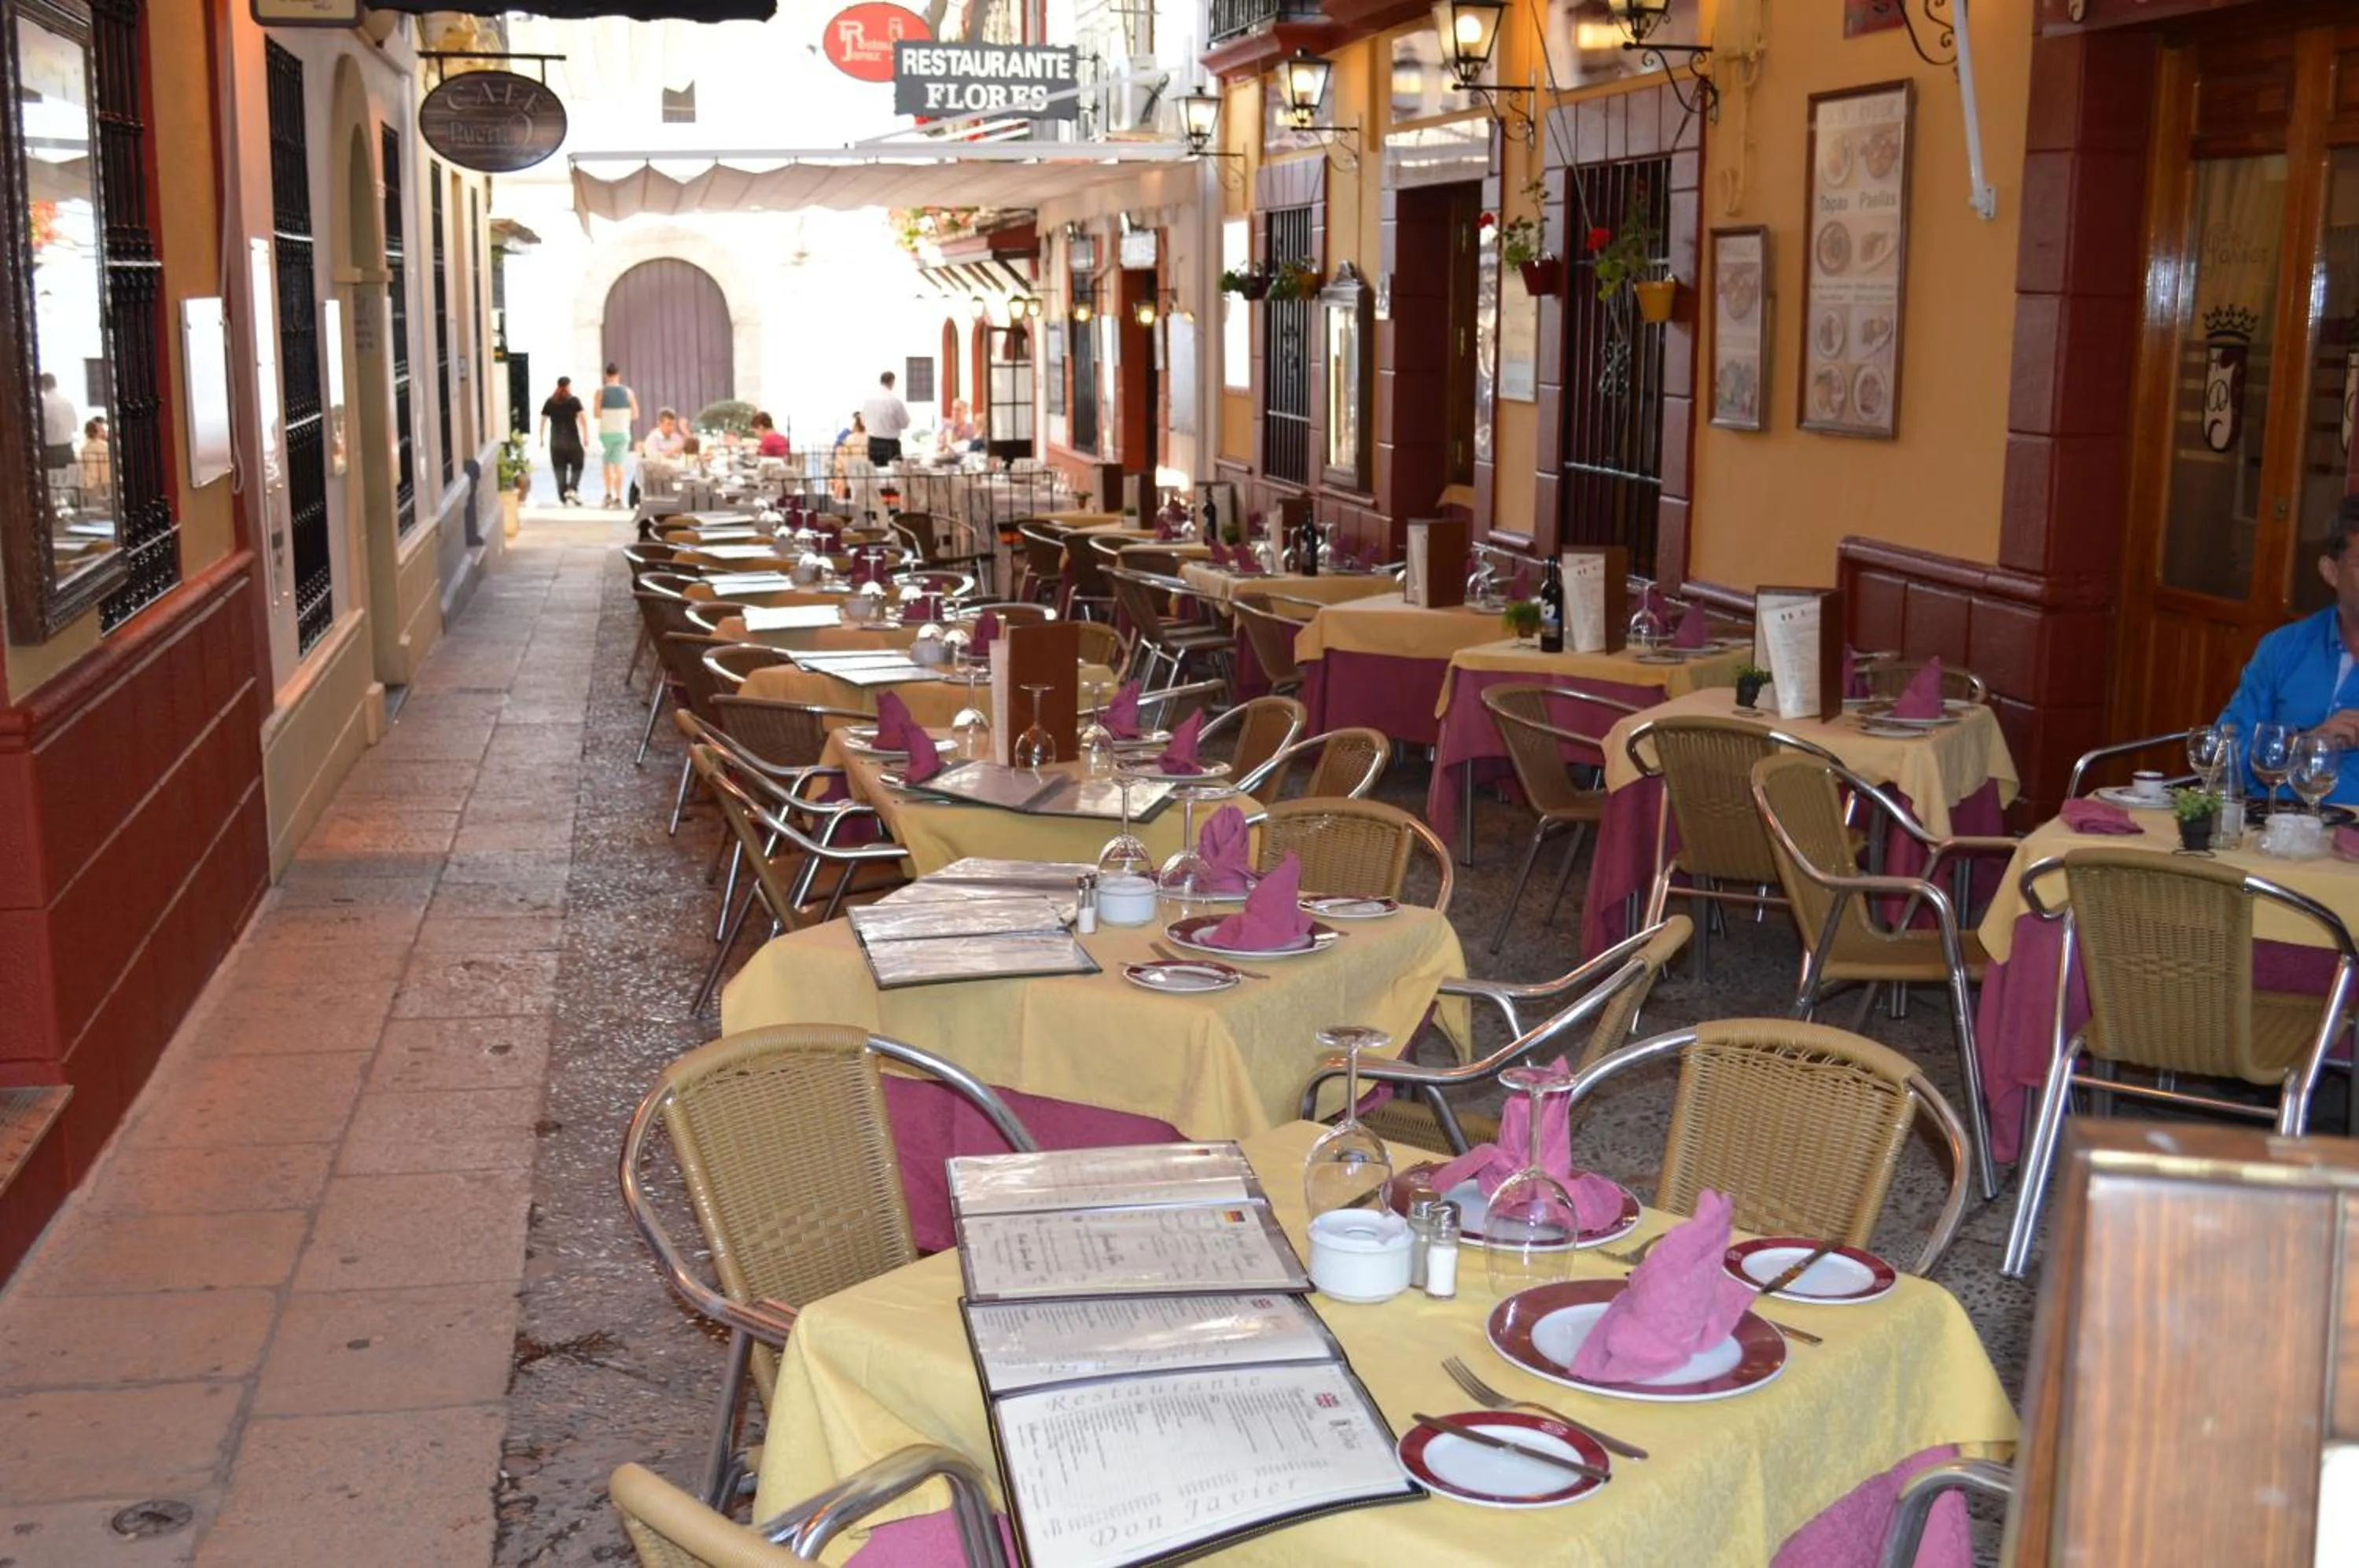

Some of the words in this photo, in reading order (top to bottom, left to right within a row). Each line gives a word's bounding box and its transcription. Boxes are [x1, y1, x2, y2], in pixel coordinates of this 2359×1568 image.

[902, 47, 1070, 79] RESTAURANTE
[926, 83, 1048, 112] FLORES
[1044, 1375, 1261, 1412] Restaurante
[1089, 1515, 1163, 1548] Don
[1183, 1478, 1297, 1524] Javier
